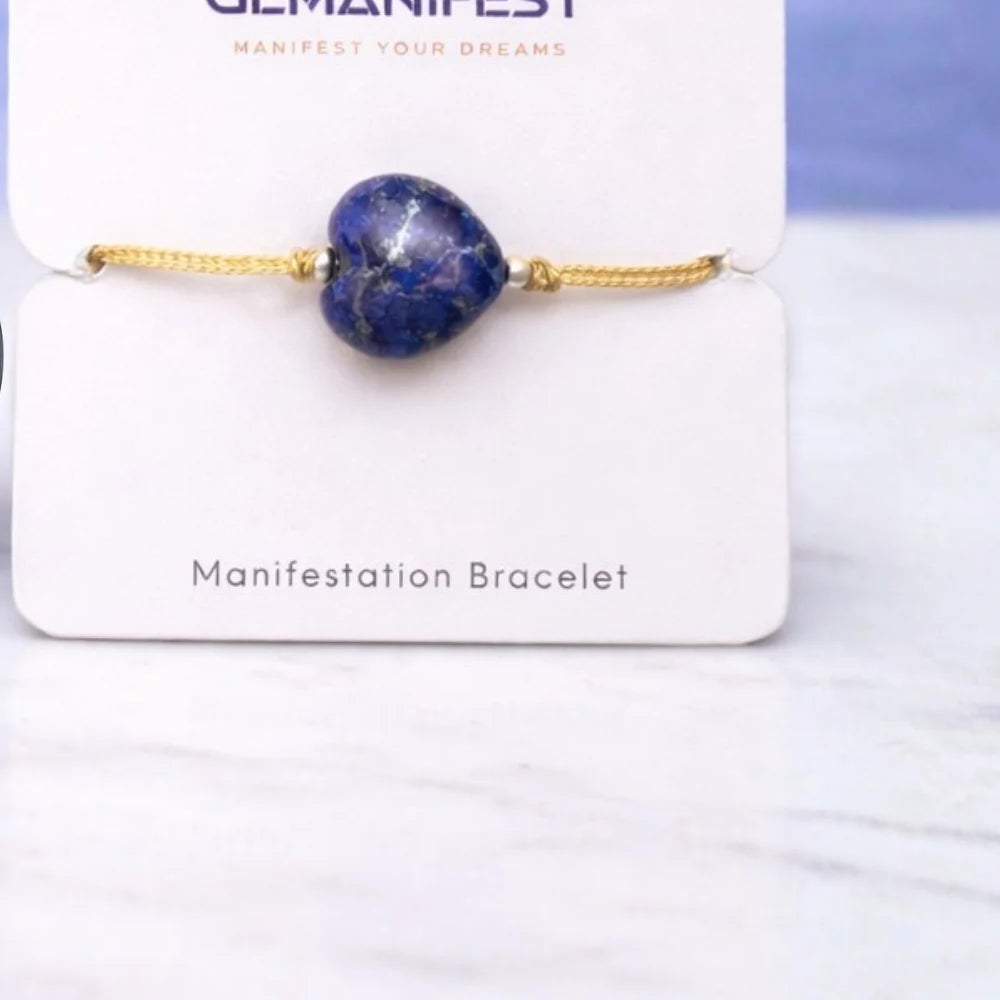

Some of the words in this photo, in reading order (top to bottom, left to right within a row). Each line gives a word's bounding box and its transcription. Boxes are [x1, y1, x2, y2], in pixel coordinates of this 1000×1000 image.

[233, 40, 363, 56] MANIFEST
[378, 41, 446, 57] YOUR
[460, 41, 567, 57] DREAMS
[191, 558, 452, 589] Manifestation
[470, 560, 628, 591] Bracelet
